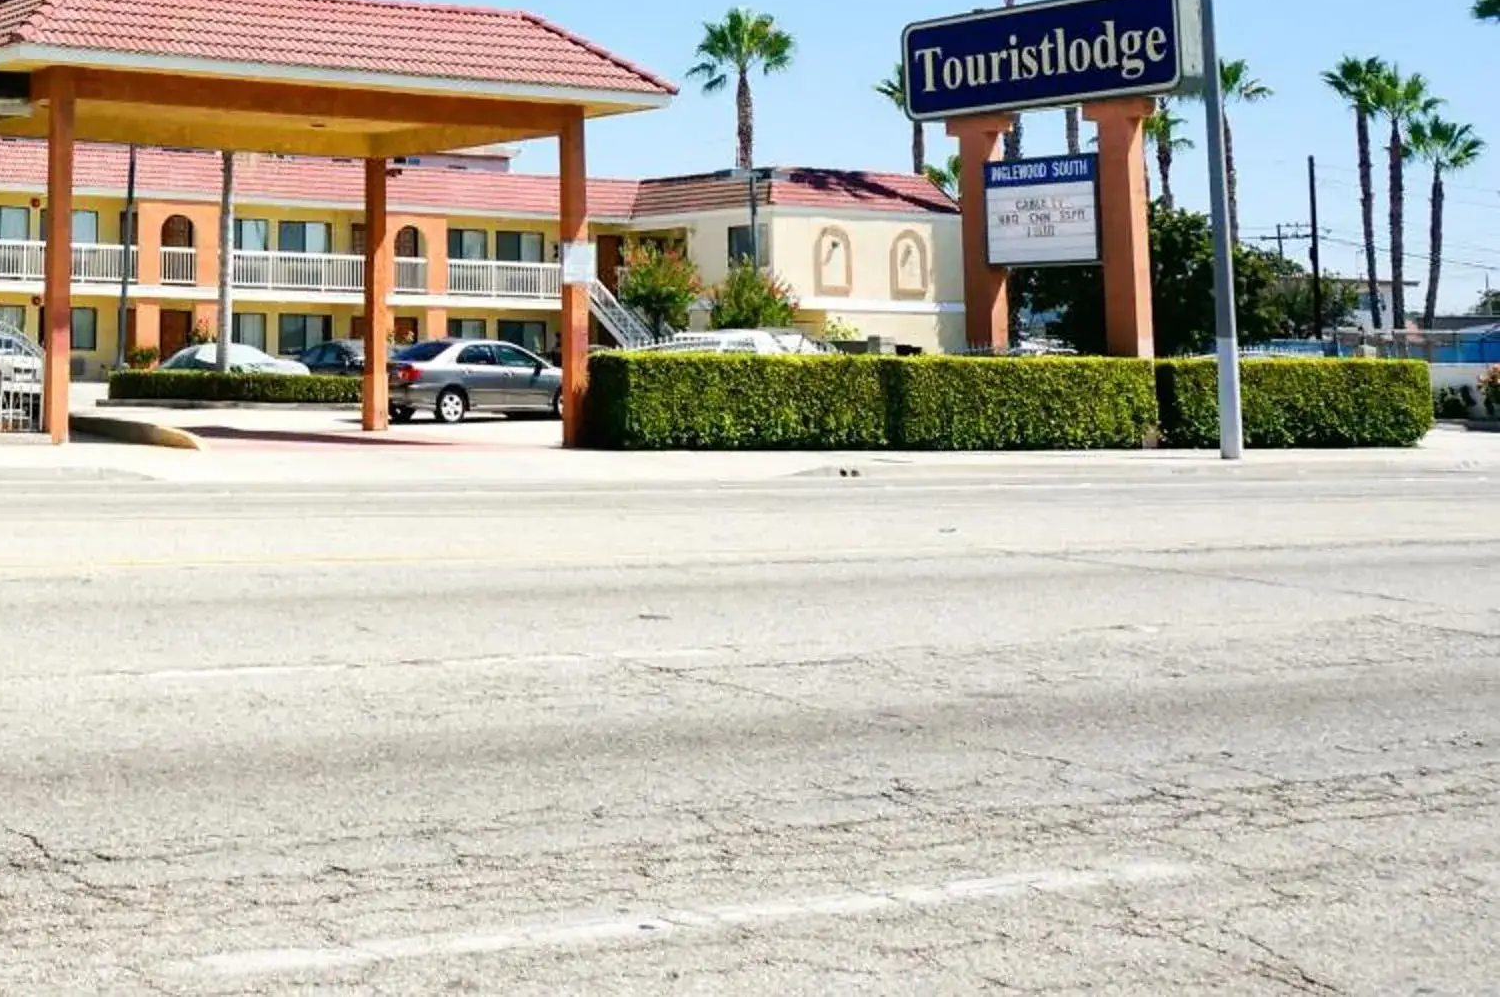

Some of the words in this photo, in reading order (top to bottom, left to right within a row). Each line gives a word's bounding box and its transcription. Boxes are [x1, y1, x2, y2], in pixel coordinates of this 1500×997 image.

[915, 20, 1167, 92] Touristlodge
[991, 163, 1047, 181] INGLEWOOD
[1051, 158, 1088, 177] SOUTH
